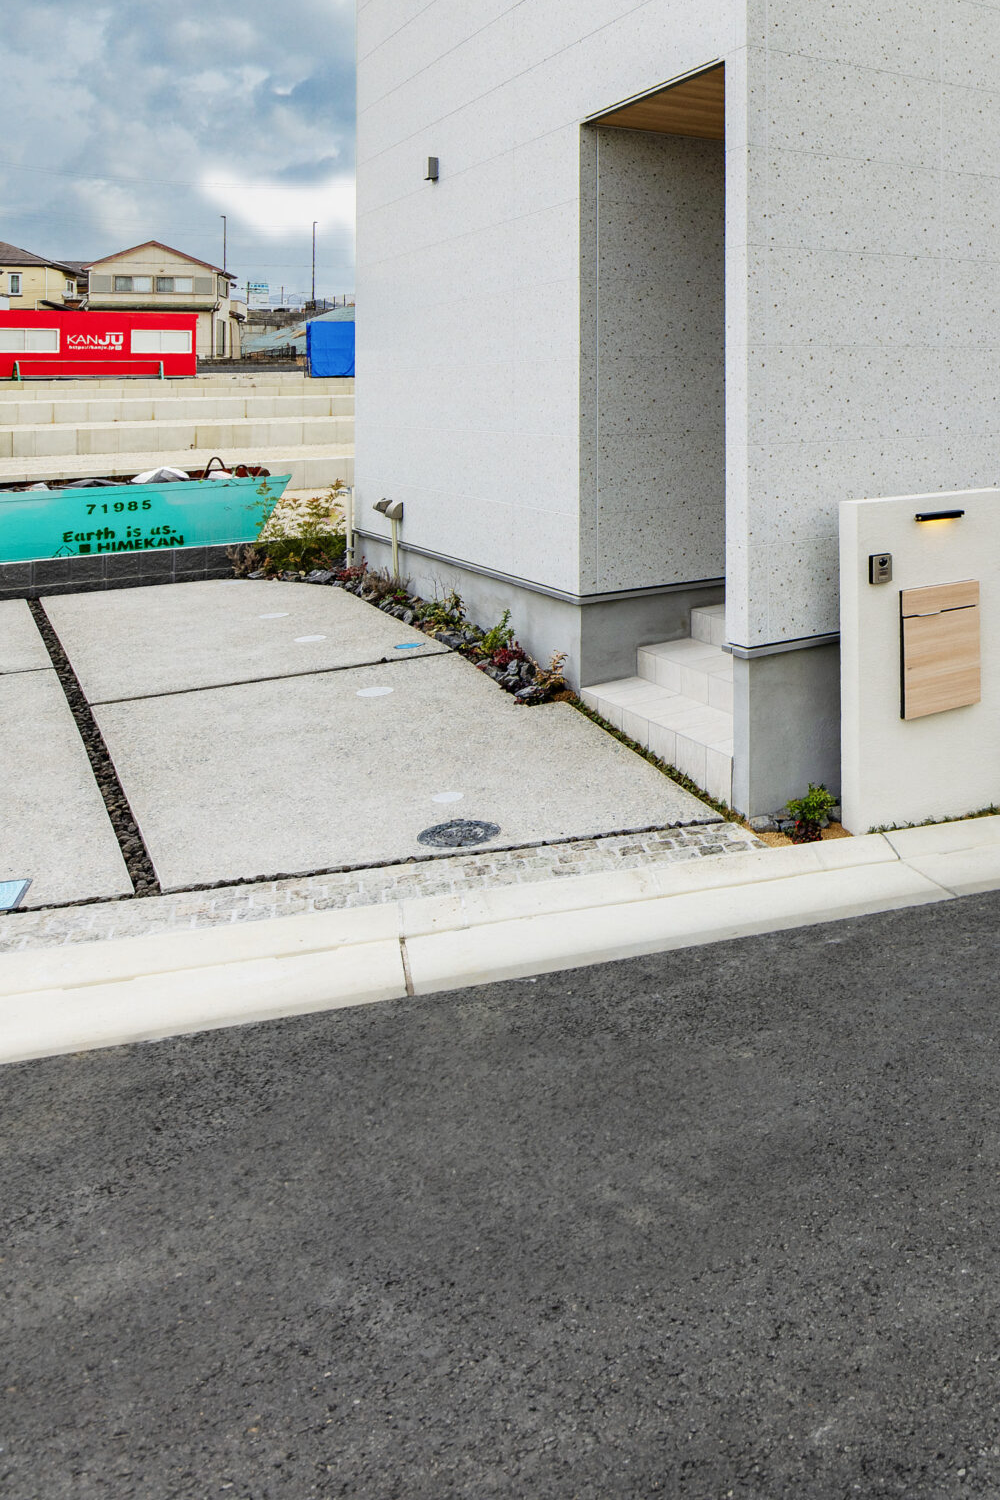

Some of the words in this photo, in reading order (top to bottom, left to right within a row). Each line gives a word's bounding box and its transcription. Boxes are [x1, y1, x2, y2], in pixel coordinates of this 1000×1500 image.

[86, 500, 152, 515] 71985
[62, 527, 115, 542] Earth
[126, 526, 141, 537] is
[150, 525, 177, 536] us.
[97, 535, 184, 552] HIMEKAN
